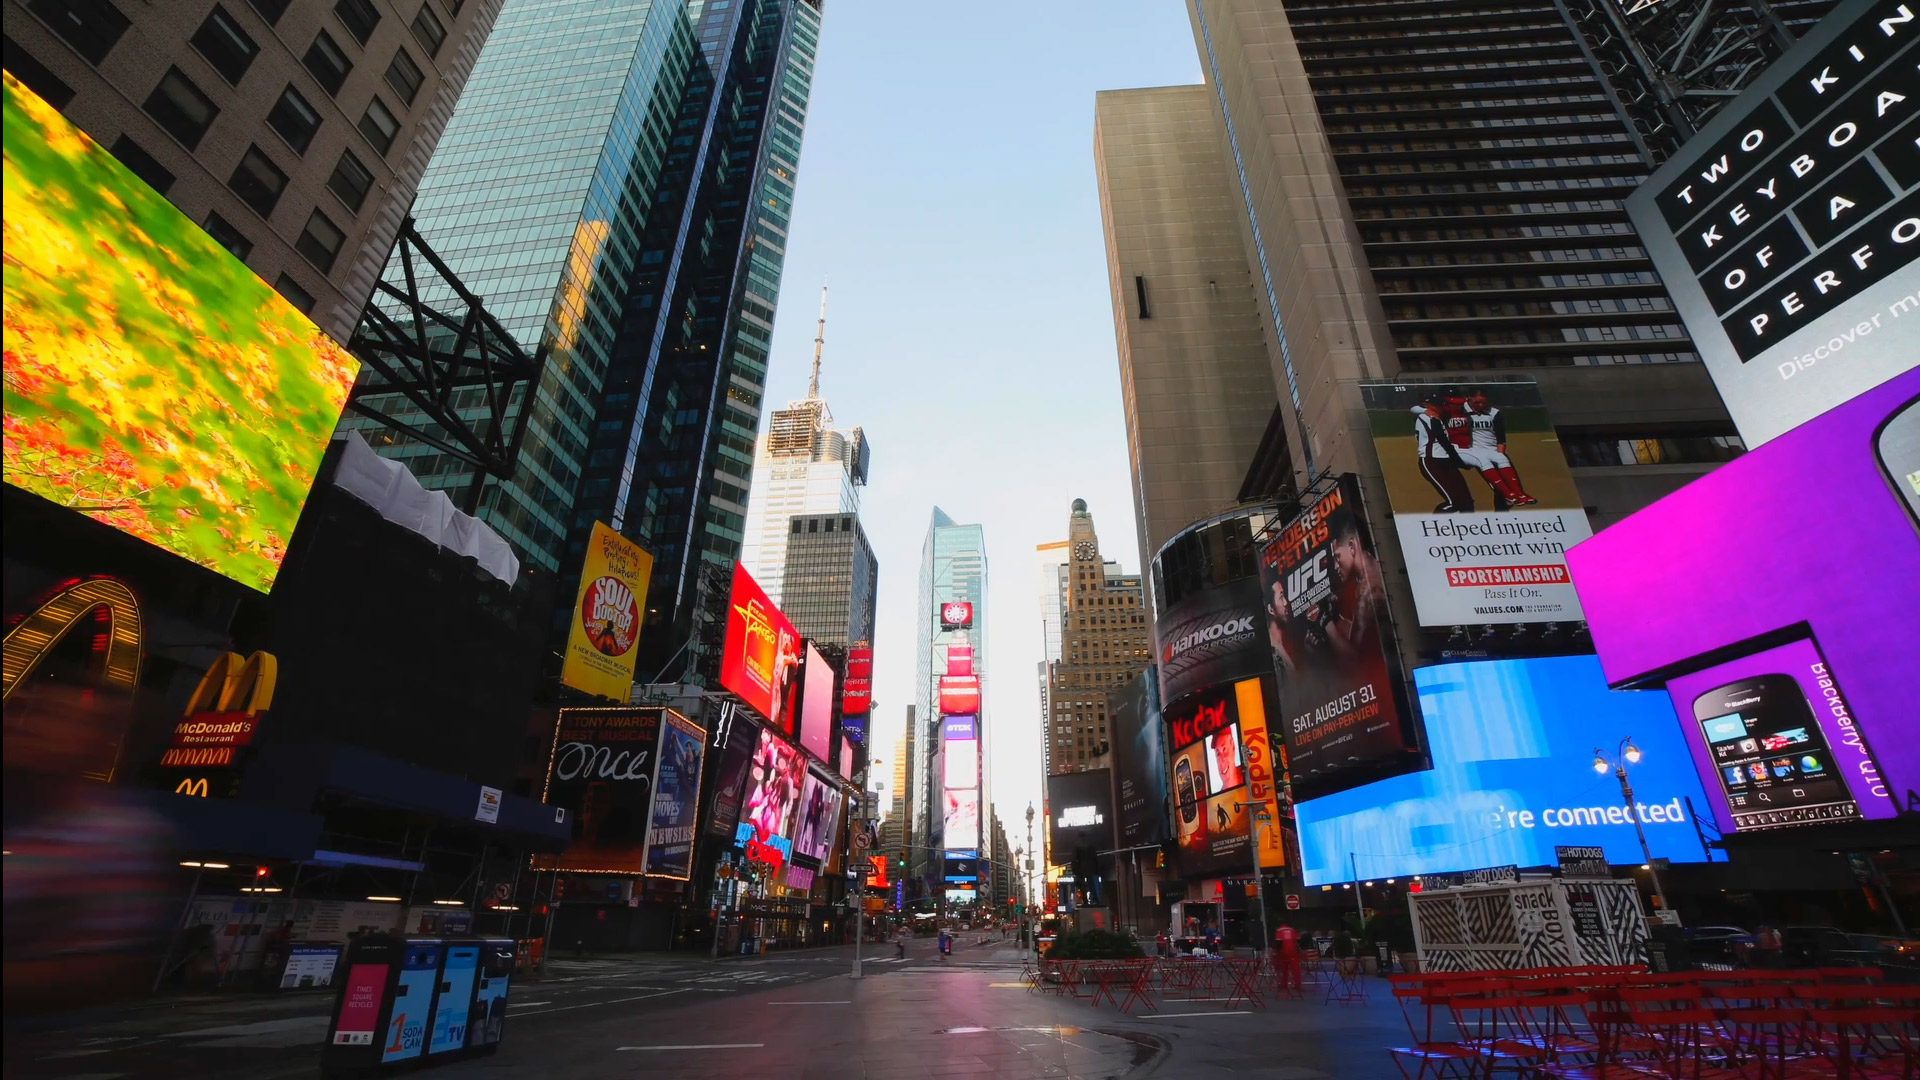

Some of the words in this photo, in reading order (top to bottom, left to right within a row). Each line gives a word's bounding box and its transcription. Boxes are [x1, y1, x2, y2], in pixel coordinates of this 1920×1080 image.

[1677, 129, 1764, 204] TWO
[1702, 64, 1920, 248] KEYBOA
[1724, 245, 1773, 290] OF
[1829, 195, 1855, 221] A
[1777, 313, 1881, 380] Discover
[1889, 290, 1920, 318] m
[1448, 417, 1465, 428] WEST
[1262, 487, 1343, 567] HENDERSON
[1421, 518, 1493, 541] Helped
[1495, 515, 1567, 539] injured
[1278, 521, 1329, 575] PETTIS
[1428, 543, 1523, 562] opponent
[1526, 537, 1565, 554] win
[1288, 549, 1327, 602] UFC
[1450, 567, 1564, 584] SPORTSMANSHIP
[595, 577, 634, 619] SOUL
[1484, 588, 1507, 599] Pass
[1509, 588, 1518, 598] It
[593, 602, 632, 633] DOCTOR
[1474, 605, 1524, 615] VALUES.COM
[1181, 642, 1210, 659] driving
[1210, 631, 1255, 647] emotion
[578, 645, 589, 655] NEW
[590, 651, 613, 665] BROADWAY
[614, 661, 632, 674] MUSICAL
[1293, 712, 1314, 733] SAT.
[1315, 691, 1357, 725] AUGUST
[1359, 683, 1377, 704] 31
[175, 721, 252, 734] McDonald's
[574, 717, 604, 728] TONY
[605, 716, 656, 727] AWARDS
[1173, 700, 1227, 749] Kodak
[1295, 732, 1311, 747] LIVE
[1312, 728, 1323, 741] ON
[1323, 702, 1379, 735] PAY-PER-VIEW
[183, 735, 235, 743] Restaurant
[562, 730, 594, 741] BEST
[597, 730, 655, 741] MUSICAL
[654, 801, 679, 817] MOVES
[1124, 799, 1145, 811] GRAVITY
[1542, 797, 1685, 827] connected
[649, 825, 692, 846] NEWSIES
[1568, 847, 1582, 858] HOT
[1583, 847, 1603, 858] DOGS
[1474, 869, 1491, 883] HOT
[1491, 866, 1516, 880] DOGS
[1514, 887, 1556, 910] snack
[1543, 910, 1567, 945] BOX
[352, 993, 373, 1001] SQUARE
[356, 985, 373, 993] TIMES
[385, 1013, 407, 1053] 1
[402, 1026, 423, 1039] SODA
[404, 1038, 421, 1050] CAN
[448, 1024, 465, 1042] TV
